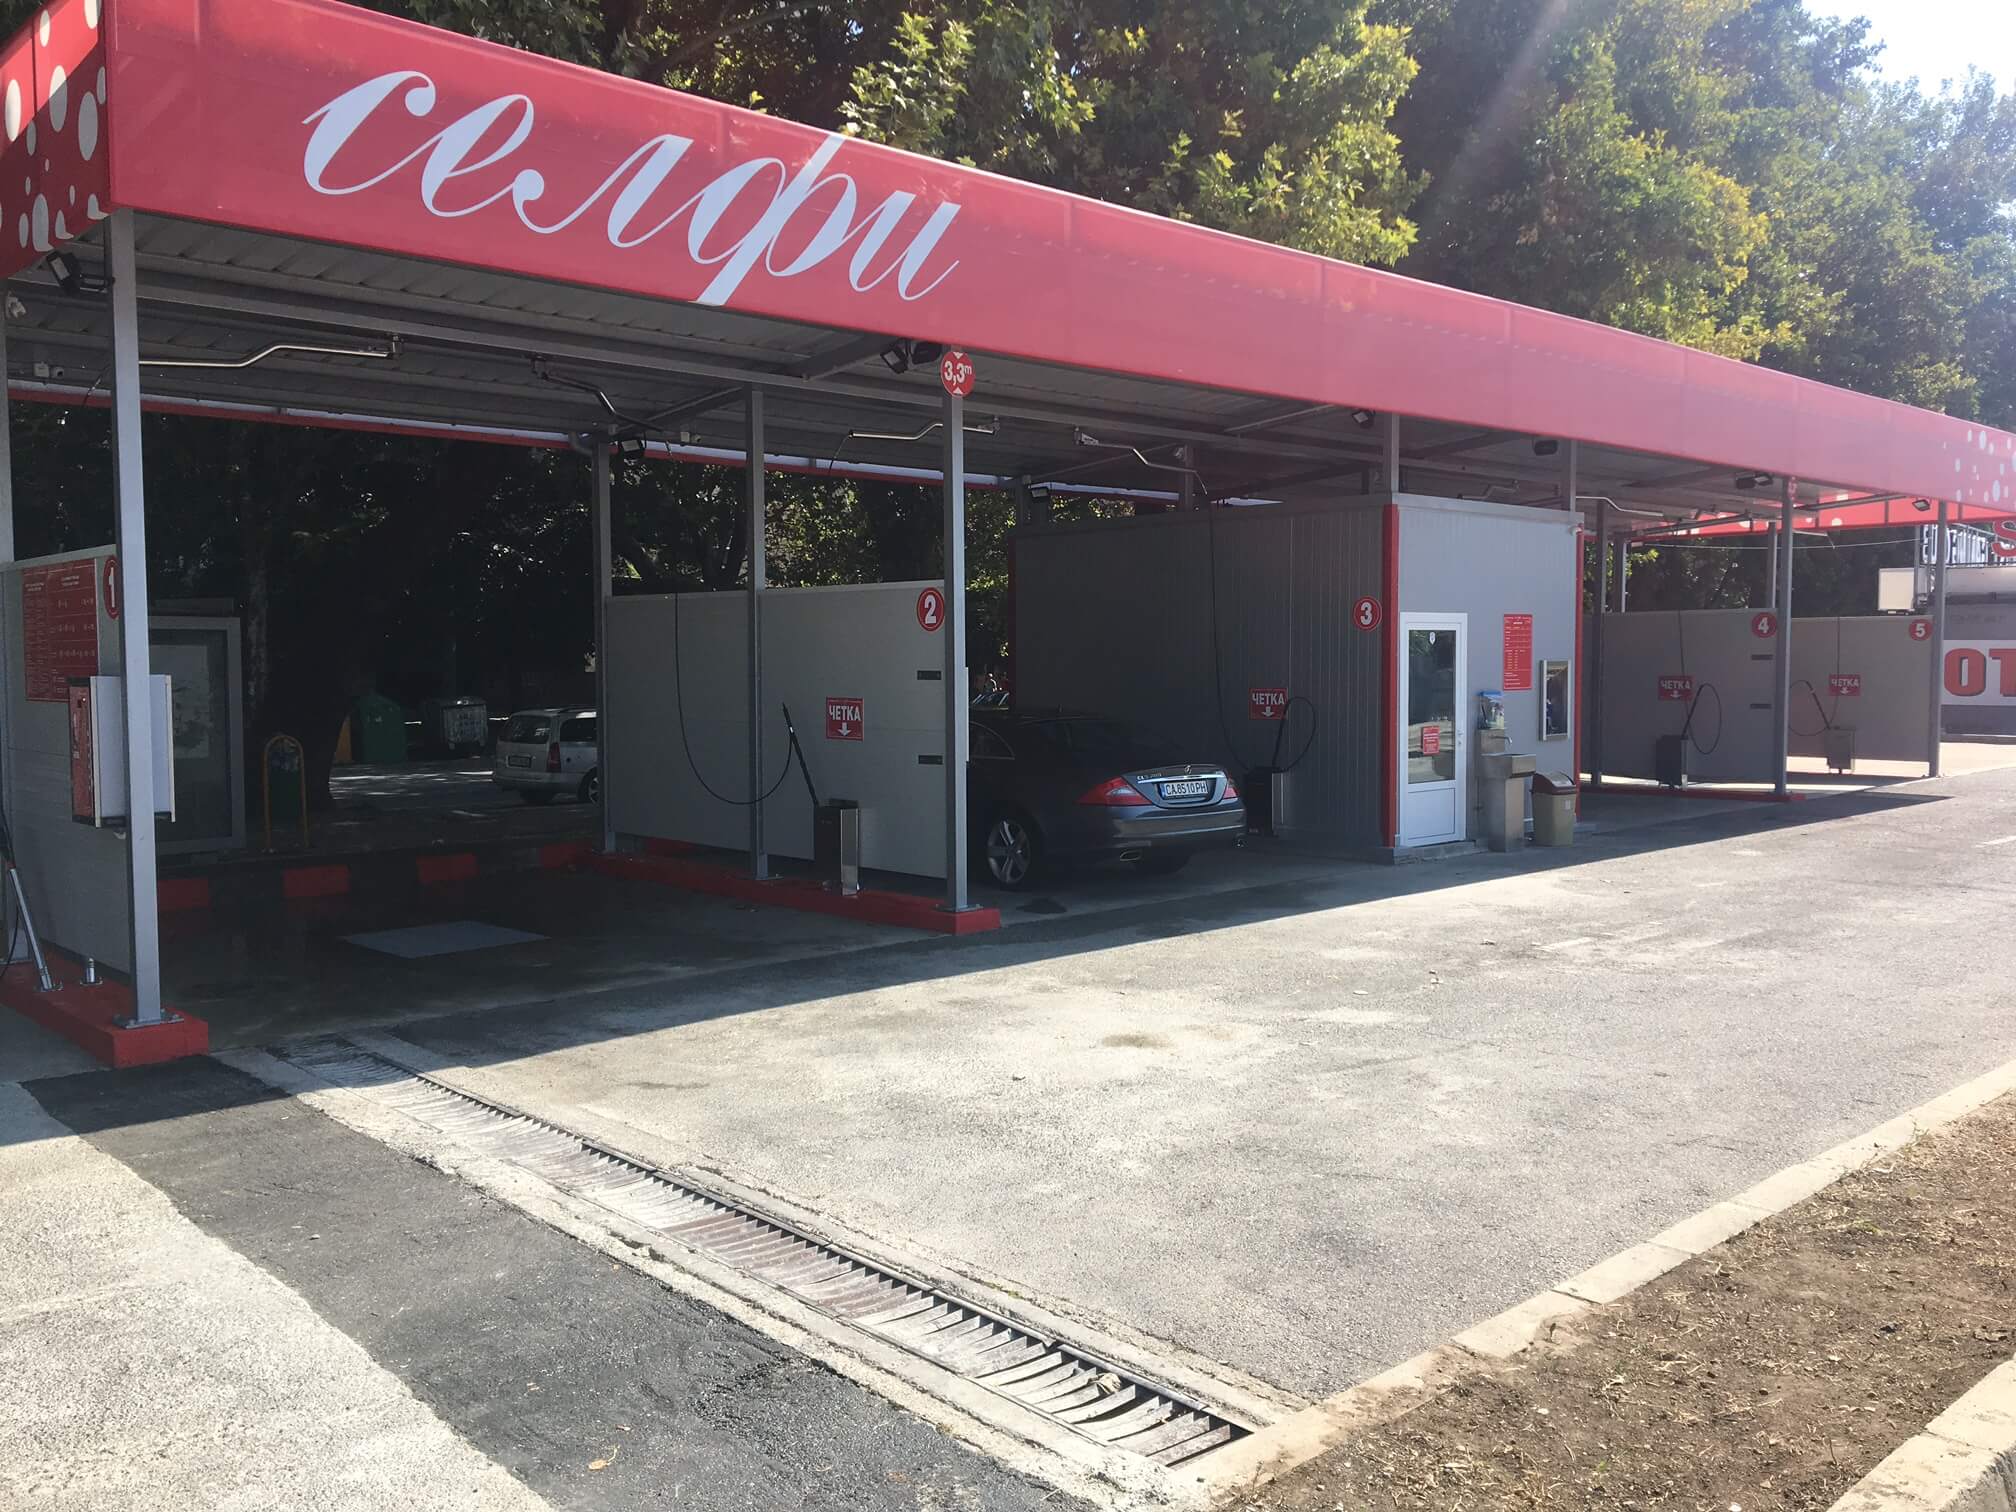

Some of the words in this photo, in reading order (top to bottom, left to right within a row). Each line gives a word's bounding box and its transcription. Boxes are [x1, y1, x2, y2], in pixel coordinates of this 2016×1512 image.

[301, 70, 962, 306] селфи
[108, 567, 116, 608] 1
[924, 594, 937, 624] 2
[1360, 601, 1373, 626] 3
[1757, 617, 1770, 634] 4
[1914, 623, 1926, 638] 5
[1660, 679, 1692, 690] ЧЕТКА
[1831, 678, 1860, 688] ЧЕТКА
[1251, 692, 1285, 706] ЧЕТКА
[828, 704, 862, 722] ЧЕТКА
